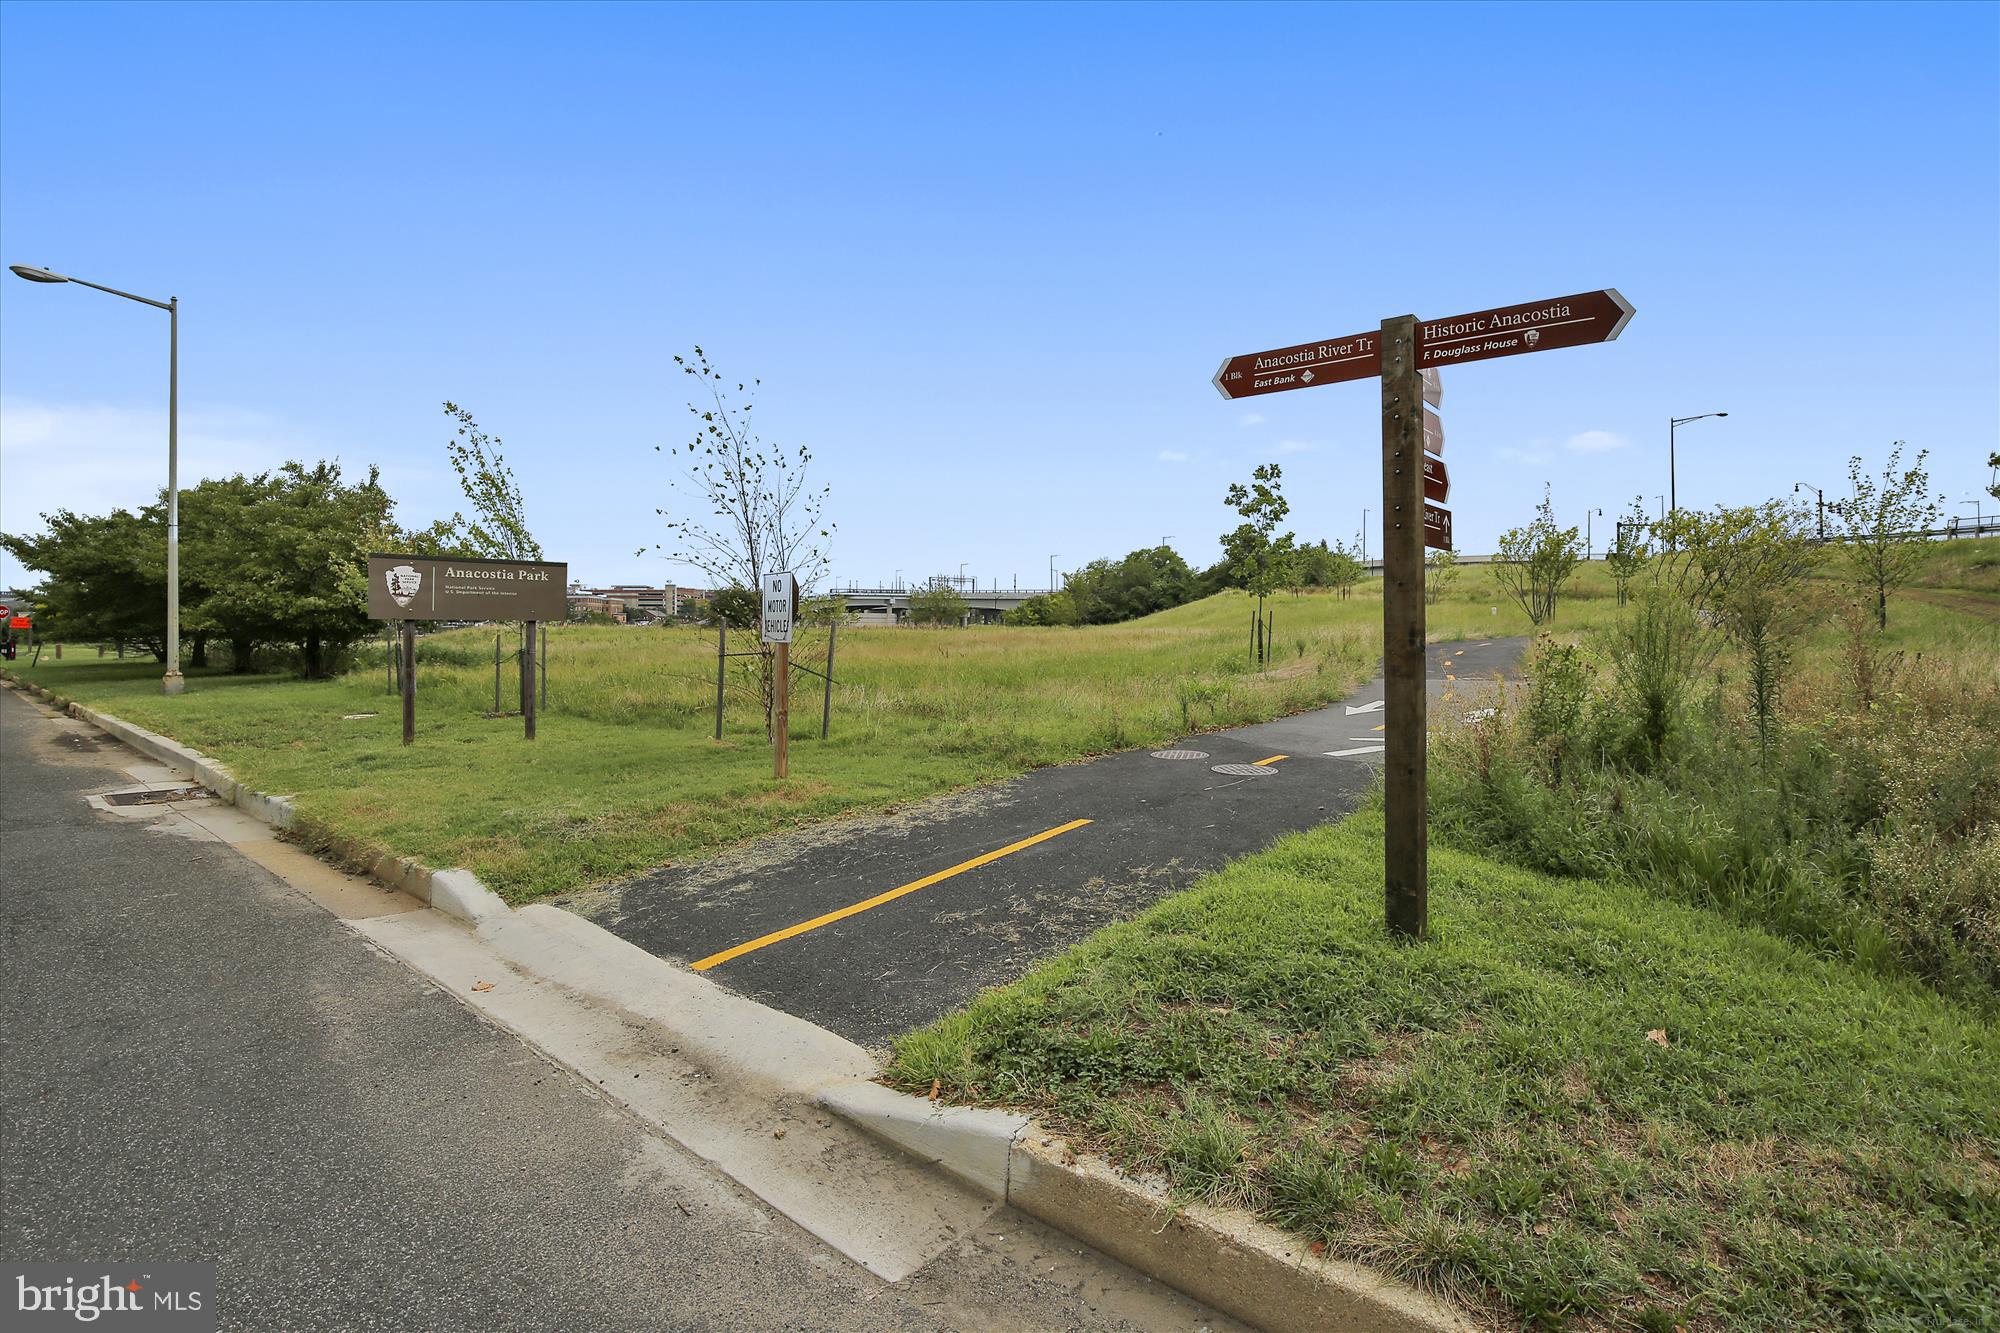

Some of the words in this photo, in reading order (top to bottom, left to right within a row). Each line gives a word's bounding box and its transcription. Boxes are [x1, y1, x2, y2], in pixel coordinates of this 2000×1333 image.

[1423, 318, 1486, 340] Historic
[1489, 303, 1571, 329] Anacostia
[1254, 349, 1315, 369] Anacostia
[1318, 343, 1353, 359] River
[1356, 337, 1373, 352] Tr
[1423, 351, 1430, 360] F.
[1433, 342, 1481, 358] Douglass
[1483, 337, 1518, 351] House
[1254, 378, 1272, 388] East
[1273, 374, 1296, 385] Bank
[445, 567, 514, 580] Anacostia
[518, 569, 549, 581] Park
[772, 580, 782, 593] NO
[767, 600, 787, 613] MOTOR
